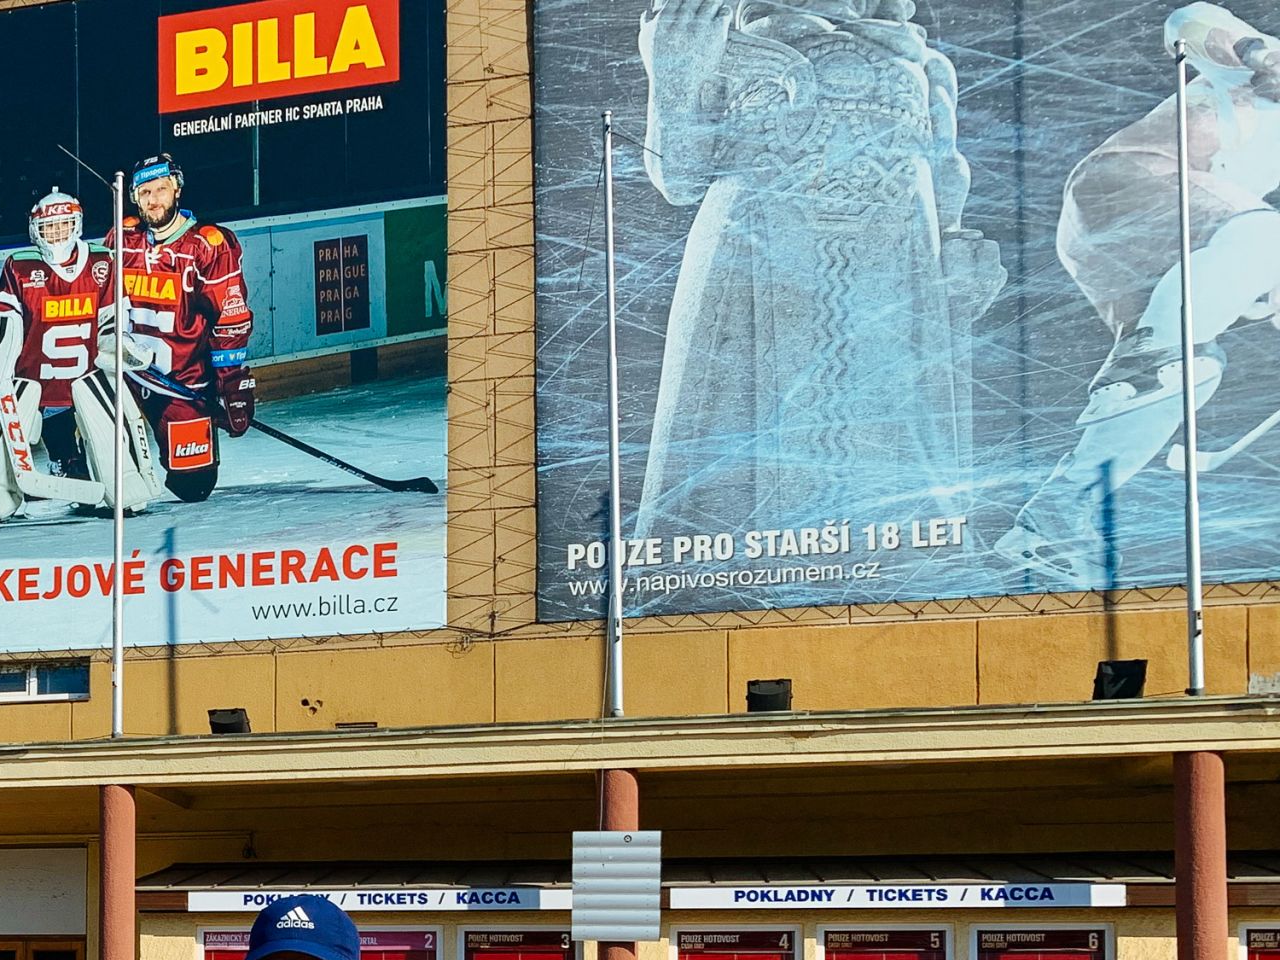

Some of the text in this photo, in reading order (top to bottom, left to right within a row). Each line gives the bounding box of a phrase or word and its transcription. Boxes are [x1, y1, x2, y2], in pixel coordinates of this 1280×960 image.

[176, 5, 386, 95] BILLA
[173, 95, 383, 136] GENERÁLNÍ PARTNER HC SPARTA PRAHA
[47, 203, 72, 215] KFC
[45, 297, 93, 318] BILLA
[0, 393, 32, 472] CCM
[175, 441, 209, 458] kika
[673, 532, 735, 564] PRO
[744, 519, 850, 560] STARŠÍ
[862, 522, 901, 552] 18
[911, 517, 967, 549] LET
[160, 541, 399, 593] GENERACE
[251, 593, 399, 622] www.billa.cz
[357, 892, 428, 906] TICKETS
[733, 889, 836, 903] POKLADNY
[866, 888, 948, 902] TICKETS
[276, 919, 315, 930] adidas
[424, 933, 433, 949] 2
[468, 934, 524, 942] POUZE HOTOVOST
[561, 934, 570, 949] 3
[680, 935, 740, 943] POUZE HOTOVOST
[778, 933, 790, 950] 4
[828, 934, 889, 942] POUZE HOTOVOST
[930, 933, 940, 949] 5
[982, 933, 1046, 942] POUZE HOTOVOST
[1088, 932, 1099, 949] 6
